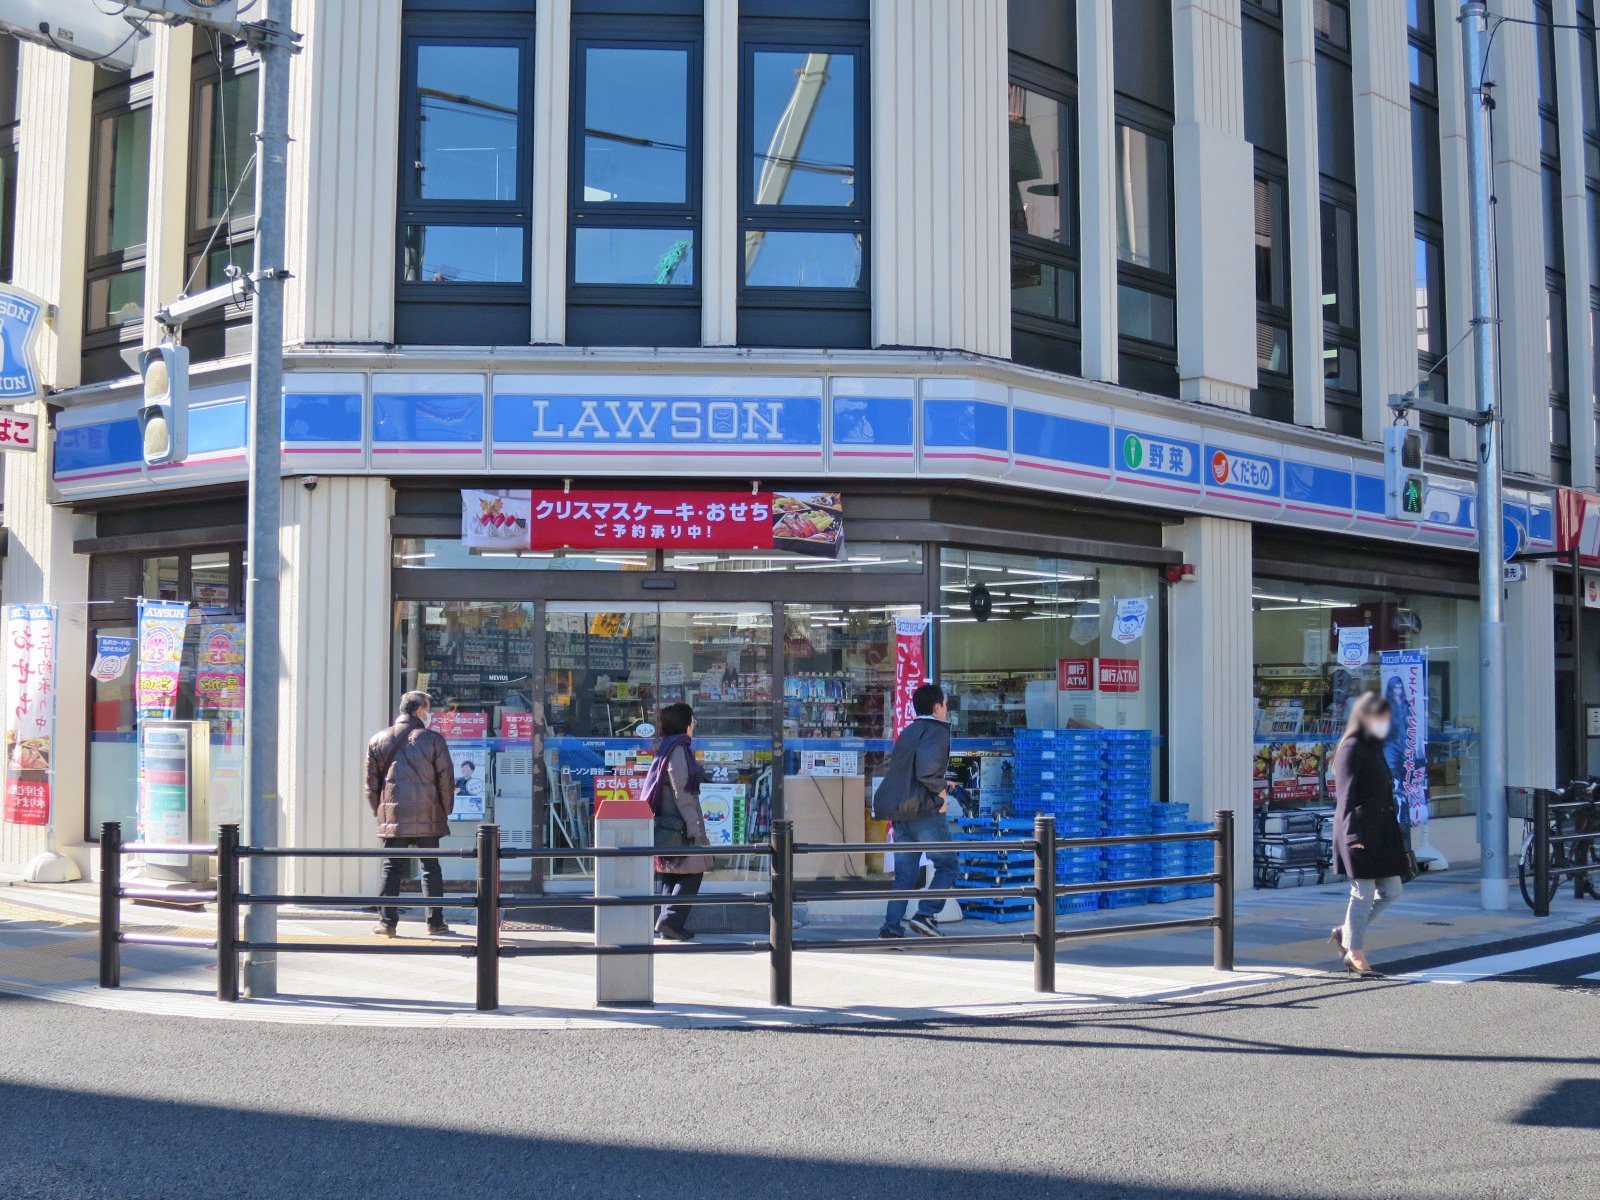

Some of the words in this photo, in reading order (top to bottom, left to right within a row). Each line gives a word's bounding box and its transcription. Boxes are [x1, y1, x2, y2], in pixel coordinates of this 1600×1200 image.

[531, 399, 784, 441] LAWSON
[1148, 443, 1185, 473] 野菜
[1230, 465, 1270, 488] くだもの
[535, 499, 769, 523] クリスマスケーキ・おせち
[593, 523, 713, 540] ご予約承り中！
[148, 648, 165, 660] 25
[1067, 664, 1085, 675] 銀行
[1100, 669, 1137, 682] 銀行ATM
[1066, 677, 1087, 686] ATM
[712, 766, 729, 777] 24
[596, 778, 626, 789] おでん
